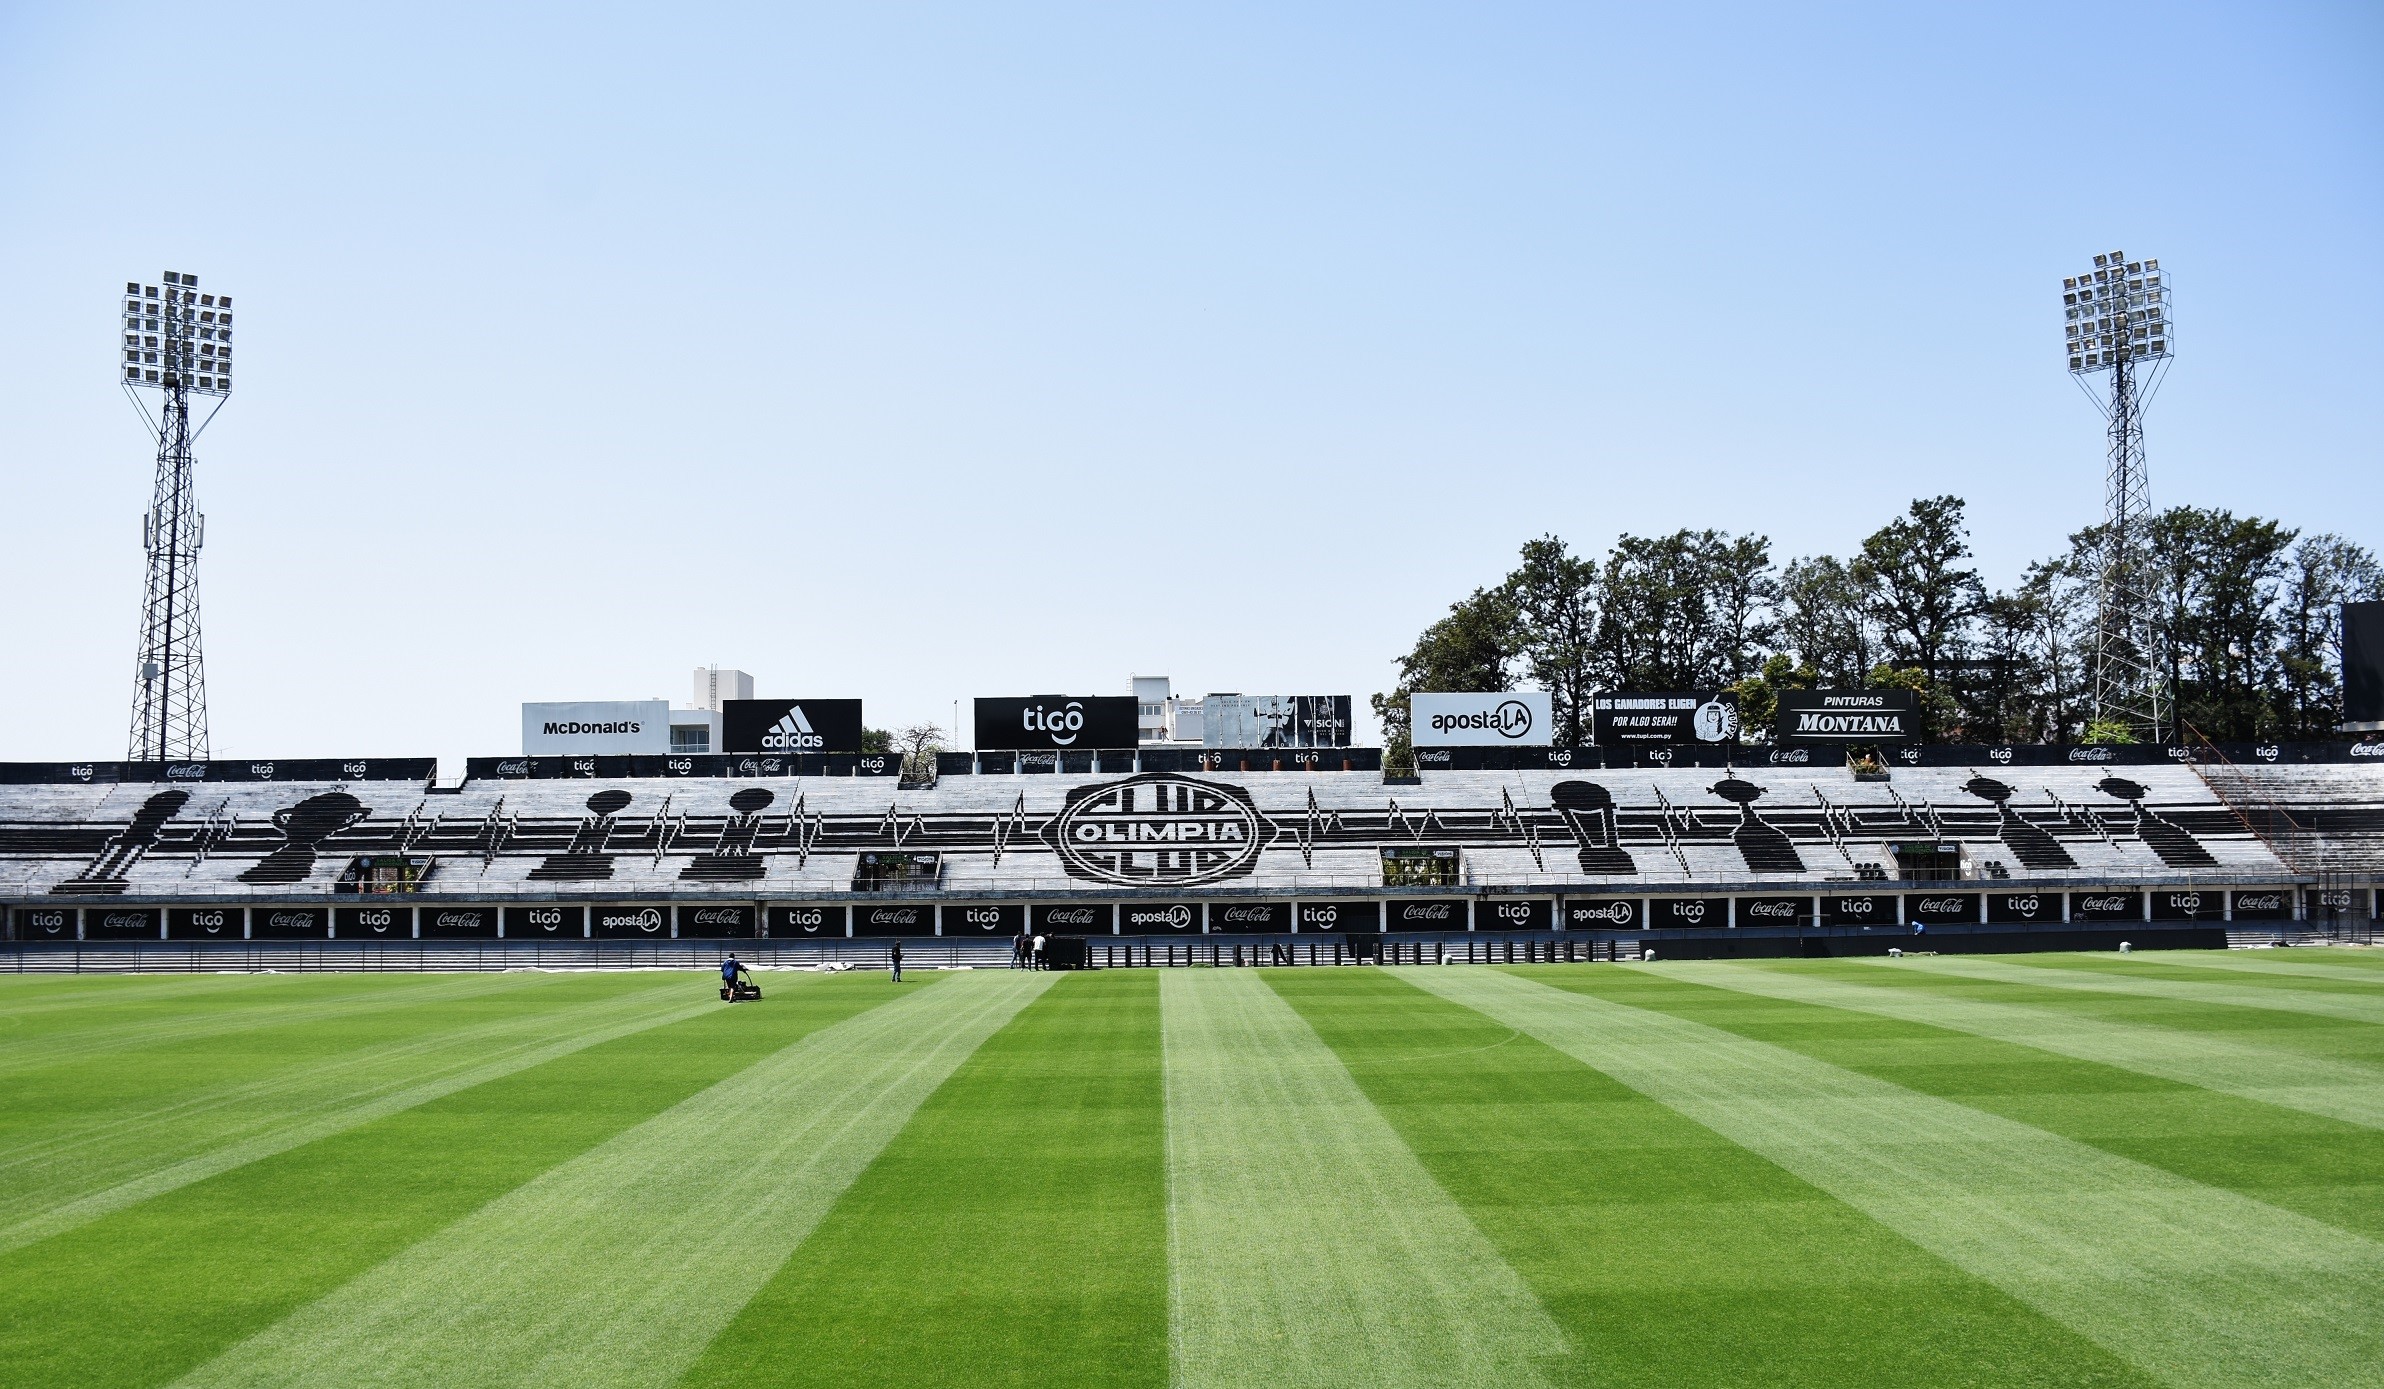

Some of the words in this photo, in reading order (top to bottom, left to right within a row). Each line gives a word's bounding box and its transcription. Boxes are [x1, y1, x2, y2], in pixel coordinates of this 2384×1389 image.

[1595, 699, 1613, 710] LOS
[1615, 699, 1666, 710] GANADORES
[1669, 699, 1697, 710] ELIGEN
[1824, 697, 1884, 706] PINTURAS
[543, 721, 640, 735] McDonald's
[1612, 716, 1627, 727] POR
[1629, 716, 1651, 727] ALGO
[1651, 715, 1678, 727] SERÁ!!
[1725, 702, 1738, 740] TUPI
[1796, 713, 1901, 732] MONTANA
[761, 732, 824, 748] adidas
[1075, 822, 1244, 842] OLIMPIA
